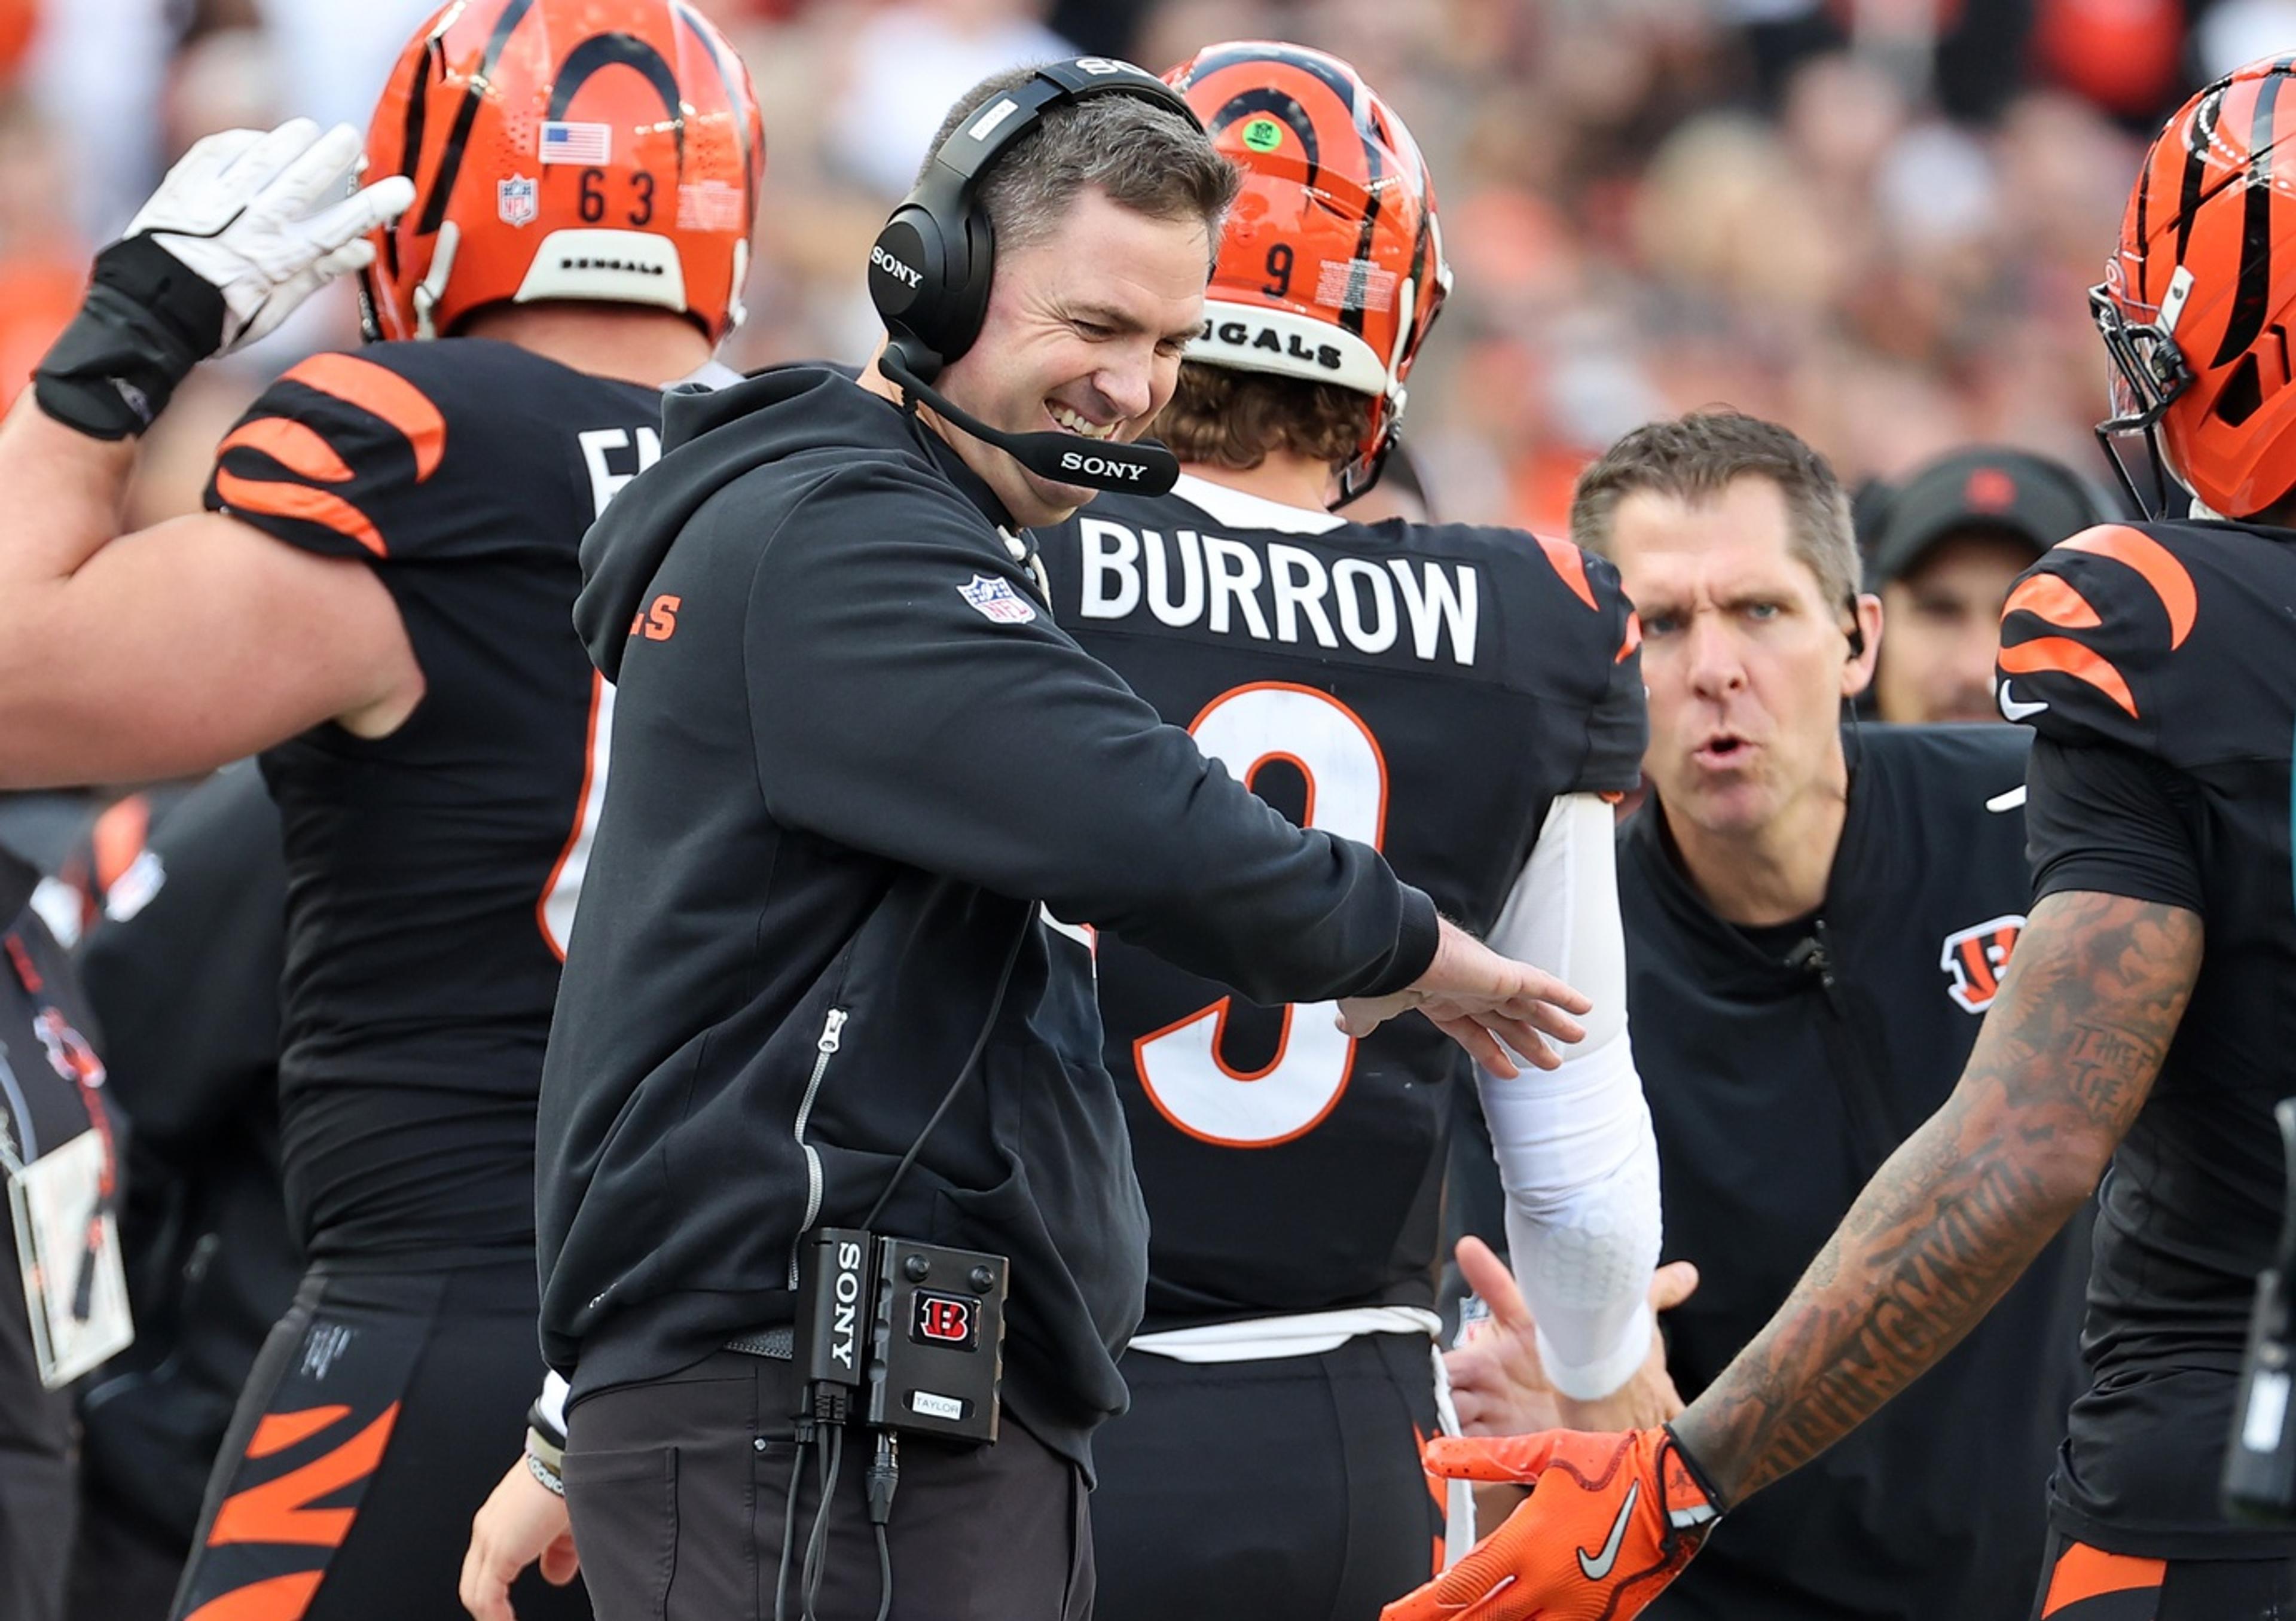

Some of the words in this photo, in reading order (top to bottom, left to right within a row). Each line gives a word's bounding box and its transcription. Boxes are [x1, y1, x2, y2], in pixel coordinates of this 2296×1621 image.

[871, 245, 924, 289] SONY
[1262, 243, 1294, 298] 9
[1060, 451, 1149, 481] SONY
[1079, 517, 1479, 667] BURROW
[1133, 680, 1389, 1148] 9
[832, 1242, 860, 1369] SONY
[916, 1396, 959, 1415] TAYLOR
